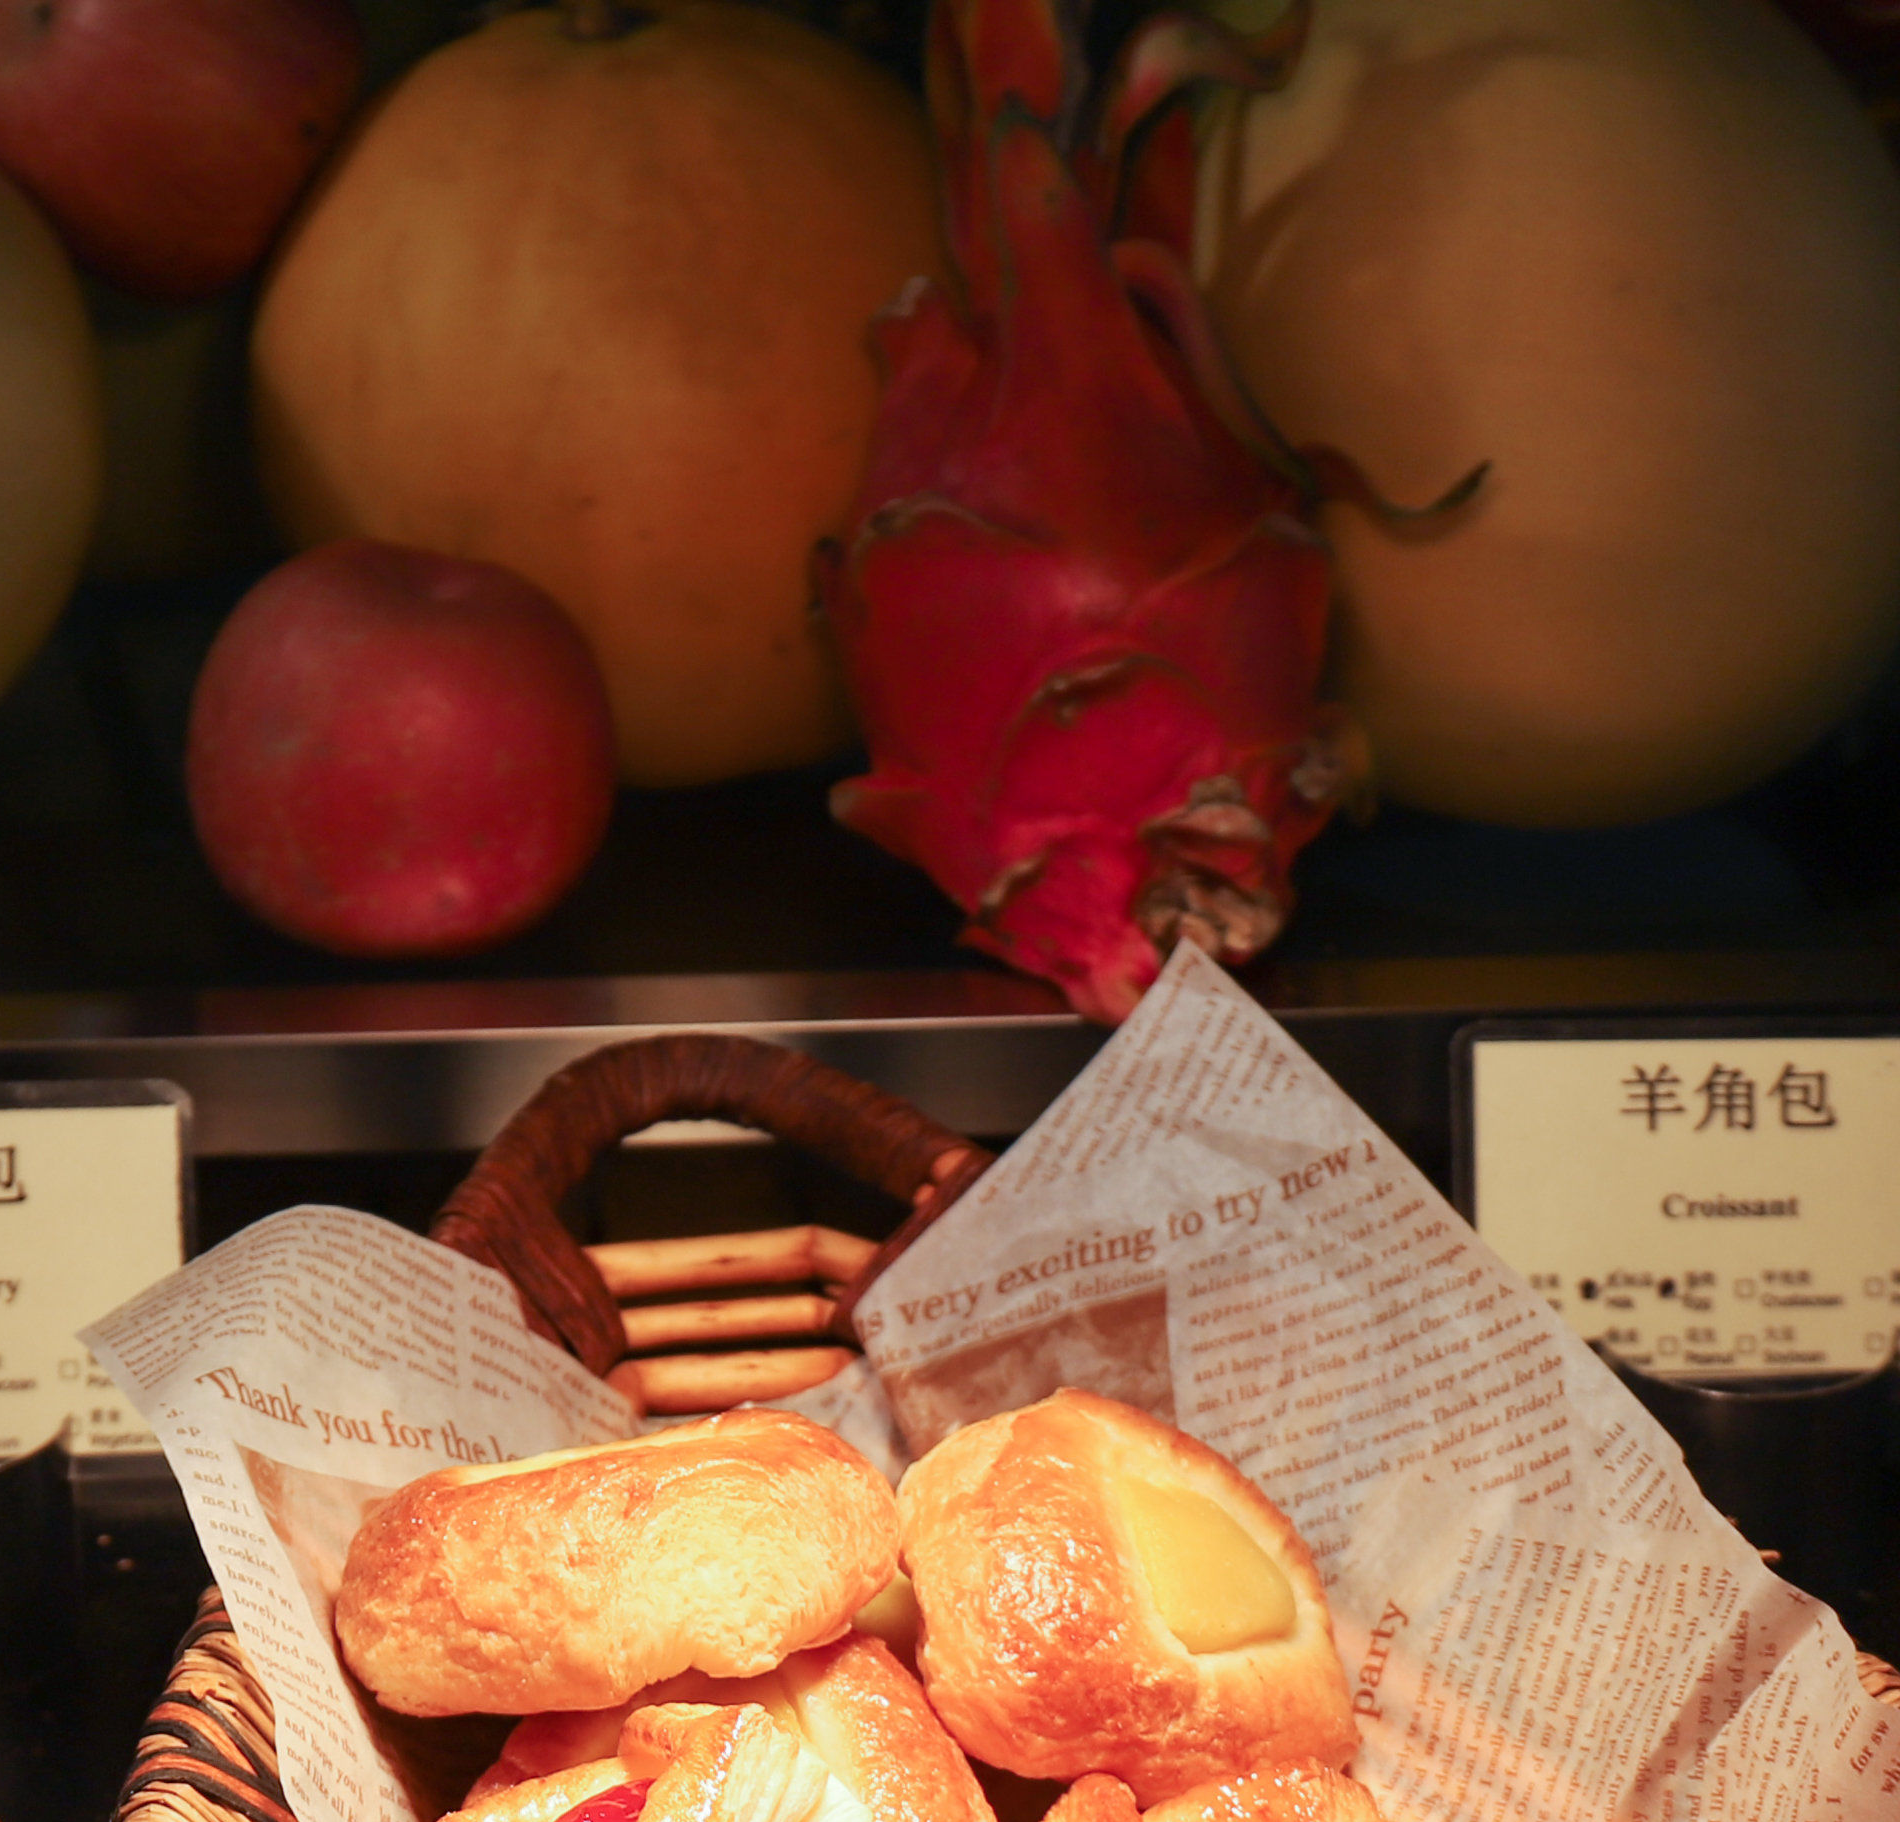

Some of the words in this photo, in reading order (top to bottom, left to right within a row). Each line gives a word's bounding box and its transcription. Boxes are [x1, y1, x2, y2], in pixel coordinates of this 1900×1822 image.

[1621, 1062, 1839, 1133] 羊角包
[1661, 1193, 1801, 1221] Croissant
[897, 1279, 986, 1326] very
[995, 1226, 1158, 1294] exciting
[1167, 1209, 1204, 1241] to
[1214, 1184, 1267, 1227] try
[1281, 1142, 1350, 1202] new
[1068, 1265, 1167, 1301] delicious
[1421, 1266, 1483, 1303] feelings
[1412, 1336, 1471, 1369] baking
[1476, 1314, 1524, 1343] cakes
[1538, 1354, 1563, 1375] the
[195, 1366, 309, 1431] Thank
[314, 1405, 376, 1444] you
[381, 1408, 435, 1452] for
[440, 1420, 496, 1465] the
[1431, 1426, 1466, 1455] held
[1469, 1415, 1500, 1438] last
[1539, 1415, 1569, 1436] was
[1457, 1527, 1483, 1566] held
[1529, 1540, 1547, 1573] and
[1594, 1551, 1608, 1569] of
[1449, 1570, 1468, 1602] you
[1472, 1642, 1487, 1658] is
[1482, 1605, 1501, 1638] just
[1503, 1538, 1527, 1583] small
[1645, 1563, 1666, 1614] which
[1672, 1581, 1687, 1617] just
[1430, 1606, 1455, 1655] which
[1442, 1653, 1462, 1688] very
[1478, 1533, 1505, 1573] Your
[1493, 1577, 1534, 1663] happiness
[1527, 1634, 1557, 1702] towards
[1564, 1549, 1585, 1582] like
[1571, 1577, 1599, 1643] sources
[1609, 1593, 1642, 1675] weakness
[1634, 1562, 1652, 1587] for
[240, 1617, 300, 1658] enjoyed
[1500, 1657, 1527, 1721] respect
[1523, 1622, 1540, 1653] you
[1534, 1581, 1554, 1603] lot
[1549, 1544, 1567, 1577] and
[1563, 1714, 1580, 1750] and
[1601, 1601, 1616, 1617] is
[1610, 1557, 1633, 1593] very
[1350, 1600, 1410, 1723] party
[1484, 1666, 1503, 1697] you
[1543, 1650, 1576, 1714] biggest
[1415, 1660, 1439, 1707] party
[1473, 1700, 1491, 1740] wish
[1697, 1692, 1713, 1727] you
[1709, 1775, 1726, 1812] like
[1728, 1610, 1751, 1662] cakes
[1539, 1721, 1557, 1749] my
[1763, 1738, 1781, 1763] for
[1785, 1715, 1809, 1767] which
[1532, 1754, 1545, 1774] of
[1660, 1759, 1677, 1775] in
[1687, 1736, 1713, 1781] hope
[1849, 1745, 1872, 1775] for
